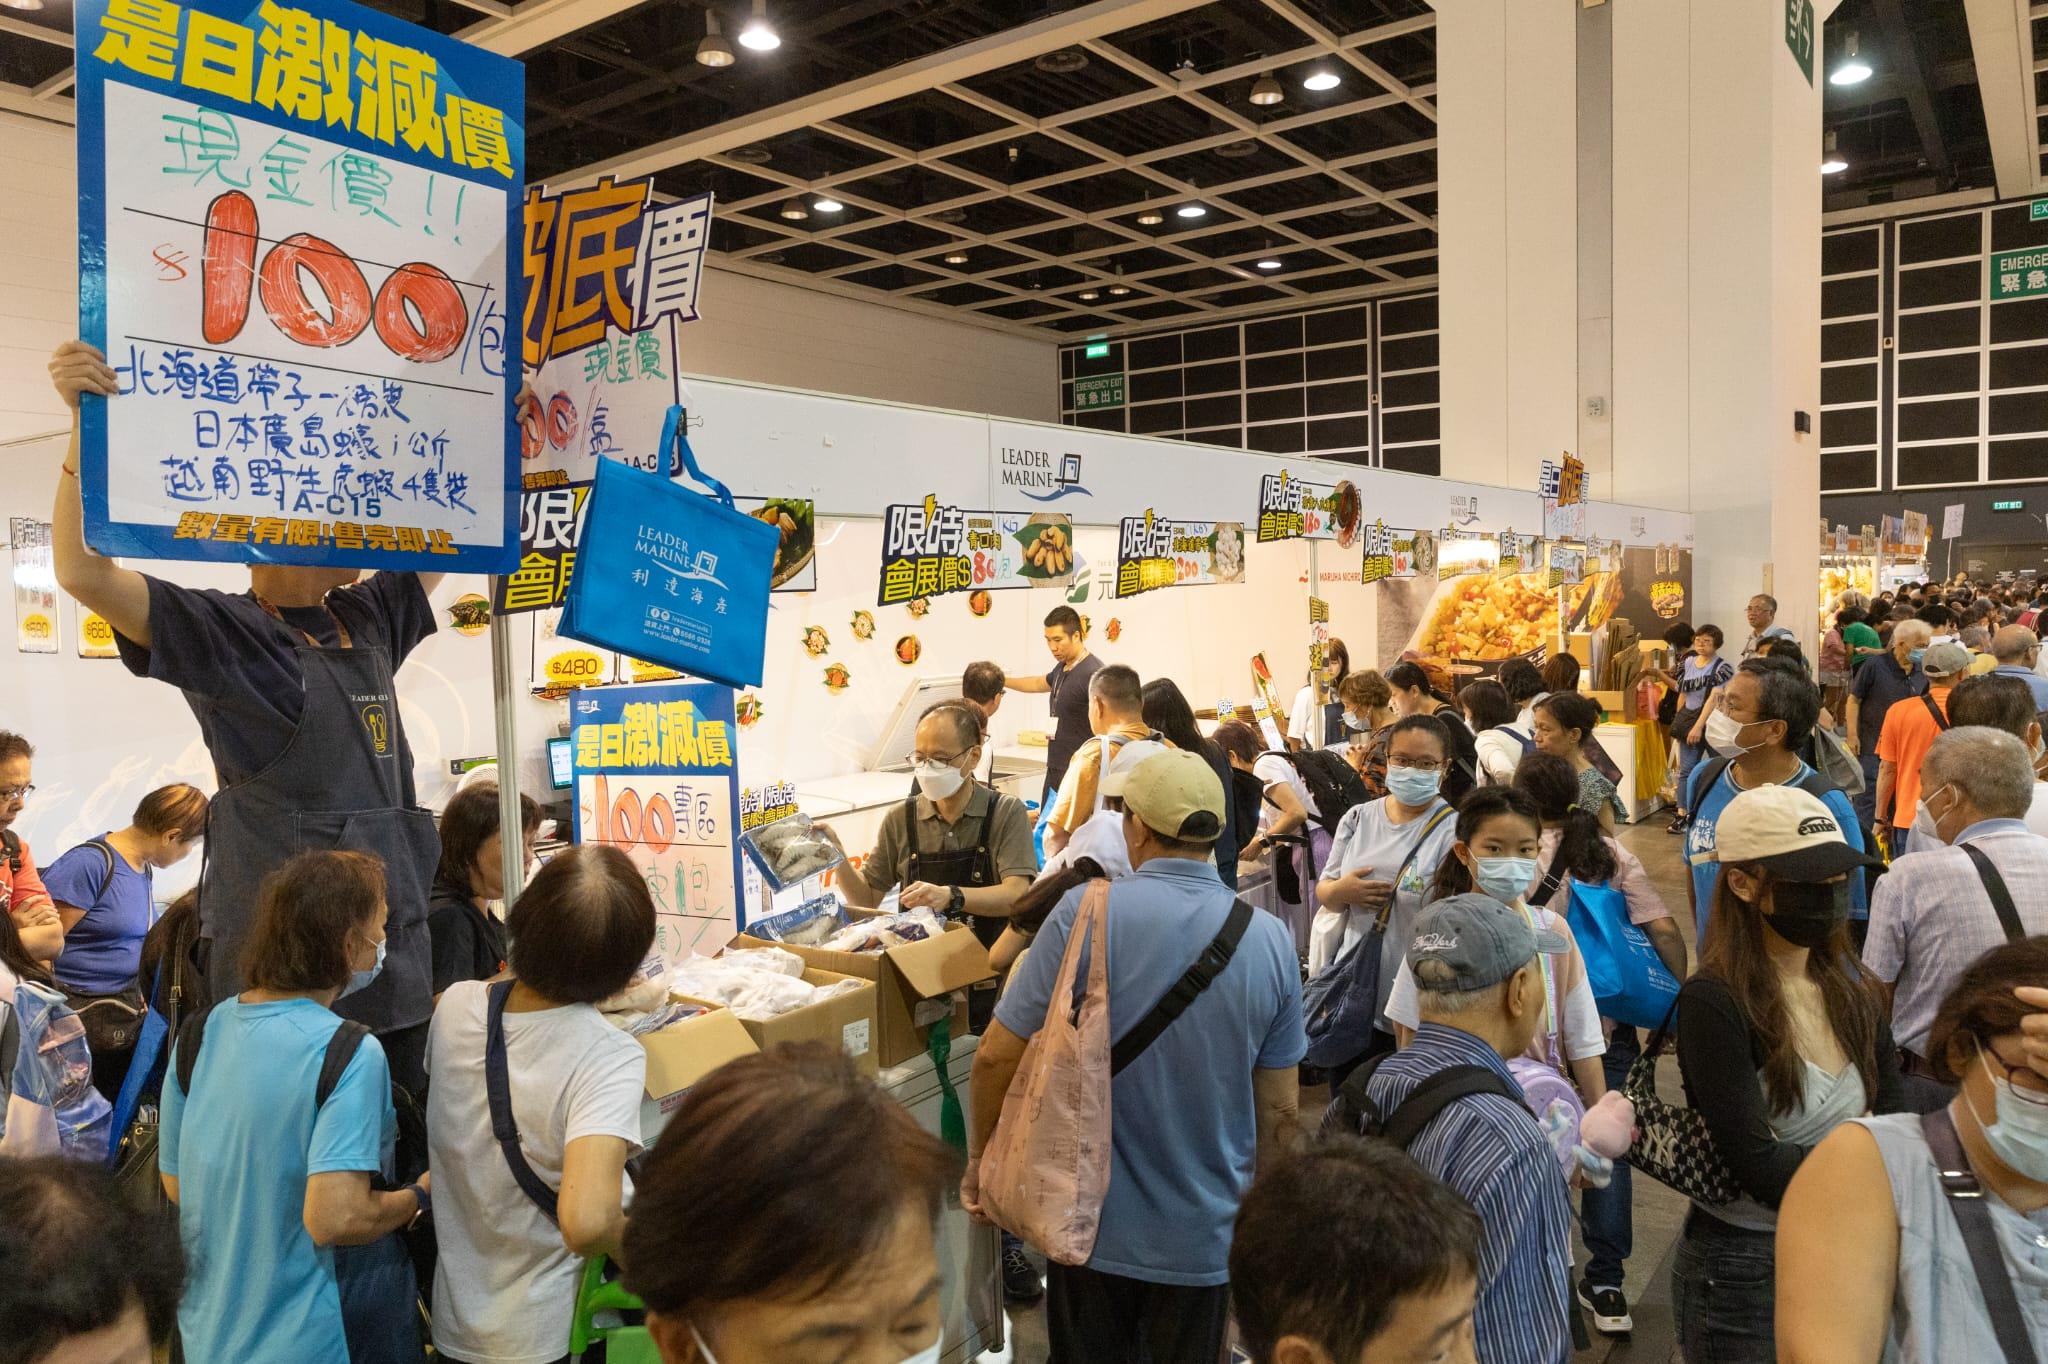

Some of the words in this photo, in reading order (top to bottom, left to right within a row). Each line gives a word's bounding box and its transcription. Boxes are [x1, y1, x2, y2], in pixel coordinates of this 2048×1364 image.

[92, 0, 515, 180] 是日激減價
[1076, 380, 1109, 391] EMERGENCY
[1111, 378, 1123, 387] EXIT
[1076, 390, 1123, 406] 緊急出口
[1002, 448, 1050, 468] LEADER
[1002, 469, 1053, 488] MARINE
[1262, 475, 1301, 512] 限時
[638, 524, 689, 554] LEADER
[888, 505, 964, 557] 限時
[1122, 518, 1171, 558] 限時
[1365, 525, 1392, 556] 限時
[635, 540, 691, 568] MARINE
[884, 553, 972, 602] 會展價$
[552, 658, 598, 677] $480
[575, 699, 733, 768] 是日激減價
[764, 783, 796, 807] 限時
[1798, 818, 1837, 836] emis
